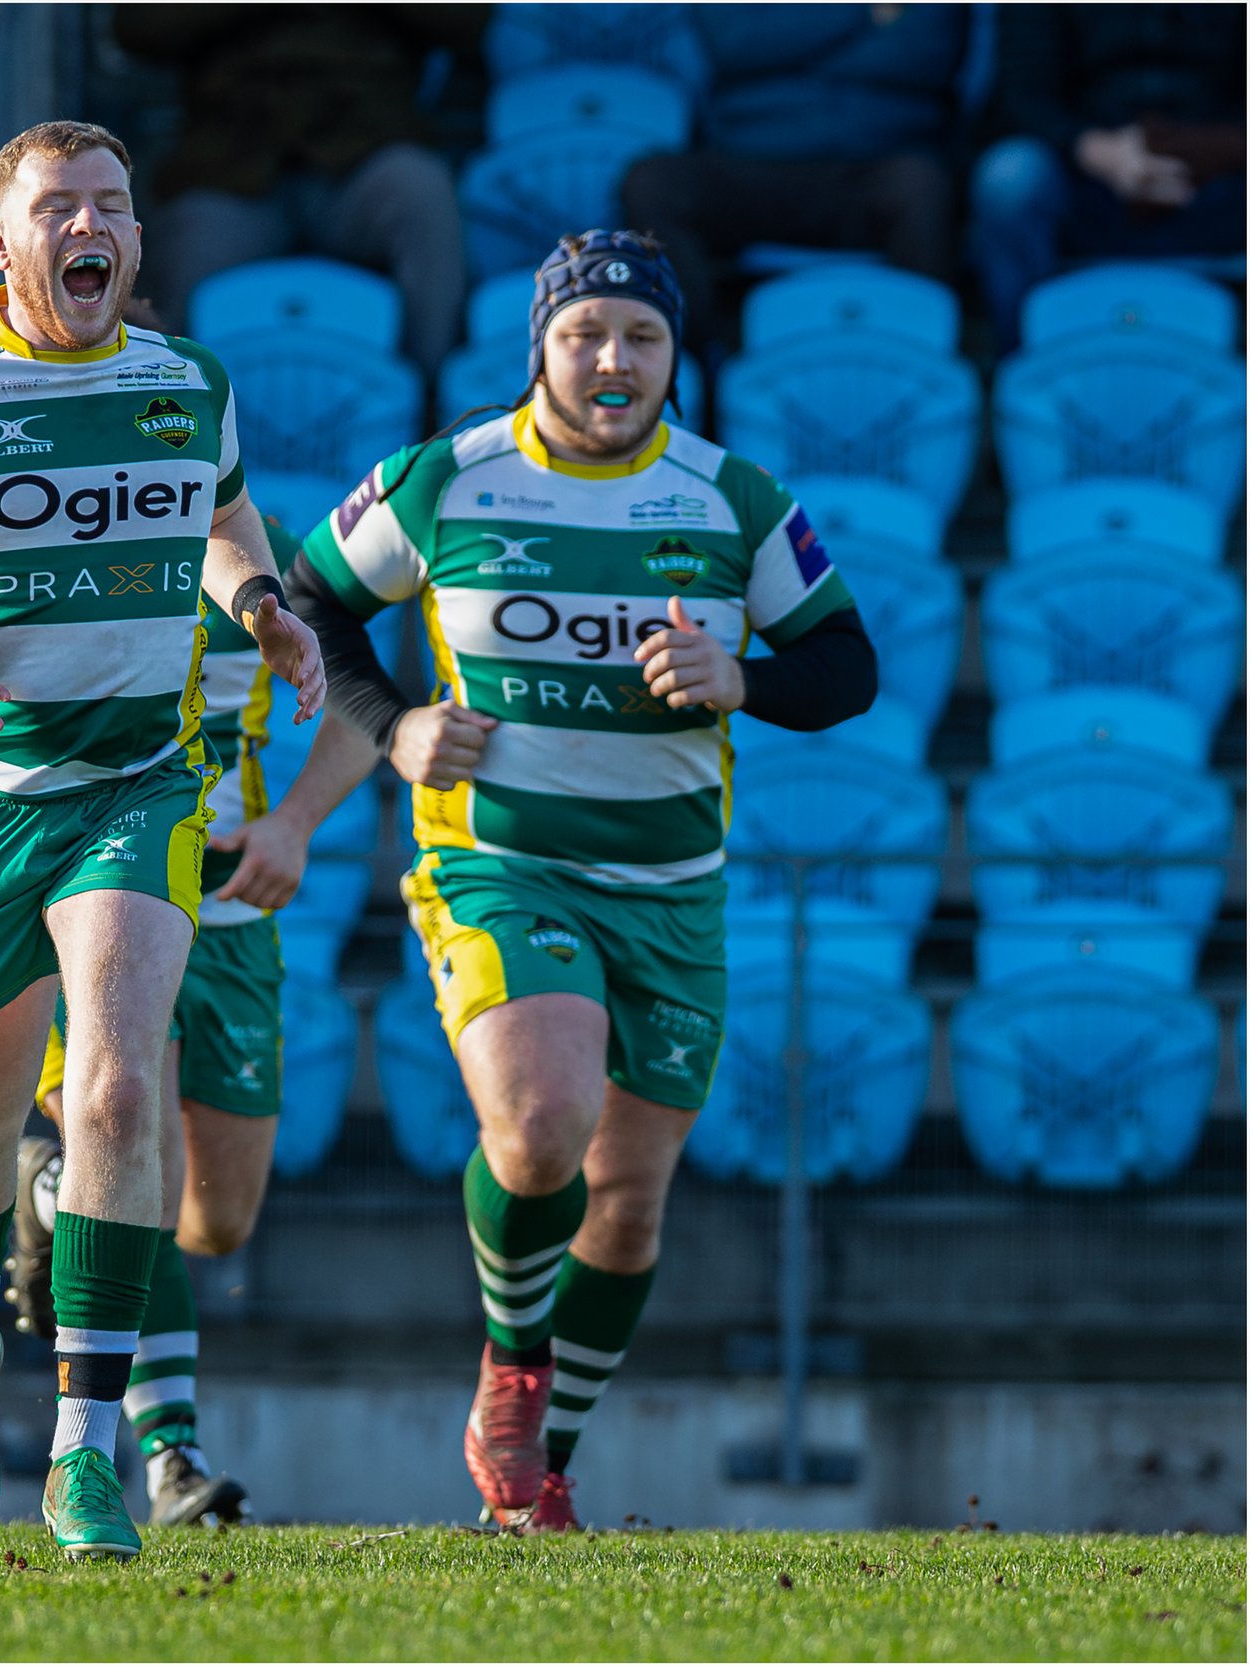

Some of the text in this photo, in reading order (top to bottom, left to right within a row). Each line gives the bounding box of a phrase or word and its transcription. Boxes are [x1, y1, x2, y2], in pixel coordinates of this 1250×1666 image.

[135, 372, 159, 380] Uprising
[141, 416, 195, 433] RAIDERS
[492, 594, 706, 660] Ogie
[501, 676, 696, 715] PRAX
